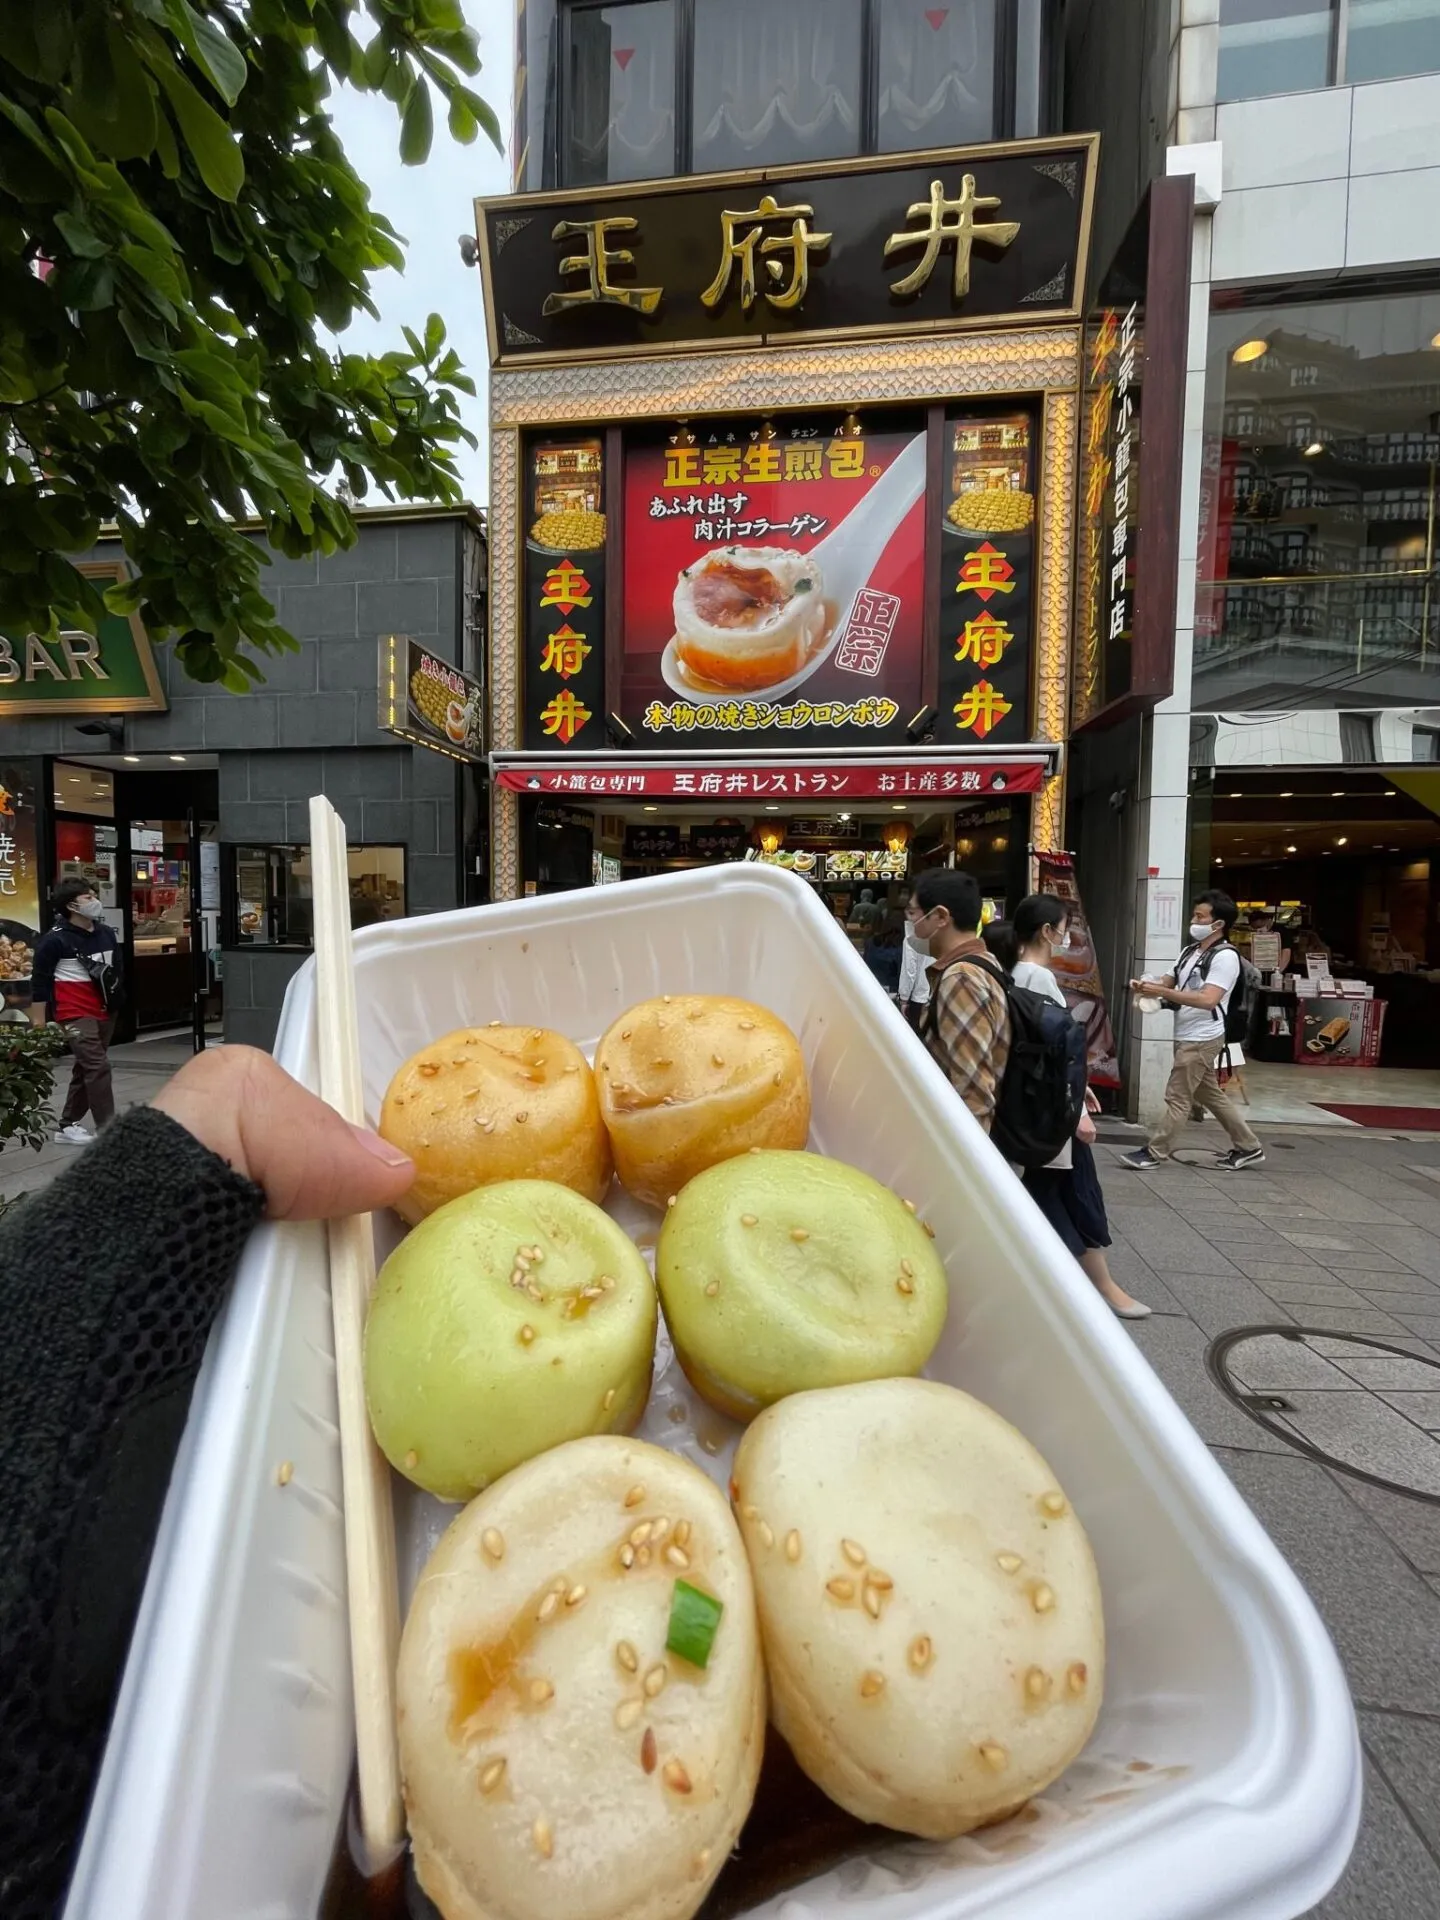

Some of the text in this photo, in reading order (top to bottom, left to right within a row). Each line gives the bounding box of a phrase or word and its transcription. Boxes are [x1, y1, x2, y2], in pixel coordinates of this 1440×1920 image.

[541, 172, 1022, 317] 王府井
[663, 438, 865, 488] 正宗生煎包
[649, 492, 748, 518] あふれ出す
[694, 514, 827, 541] 肉汁コラーゲン
[0, 630, 110, 683] BAR
[540, 568, 593, 738] 王府井
[953, 551, 1016, 732] 王府井
[644, 697, 899, 731] 本物の焼きショウロンポウ
[549, 770, 982, 793] 小籠包専門 王府井レストラン お土産多数
